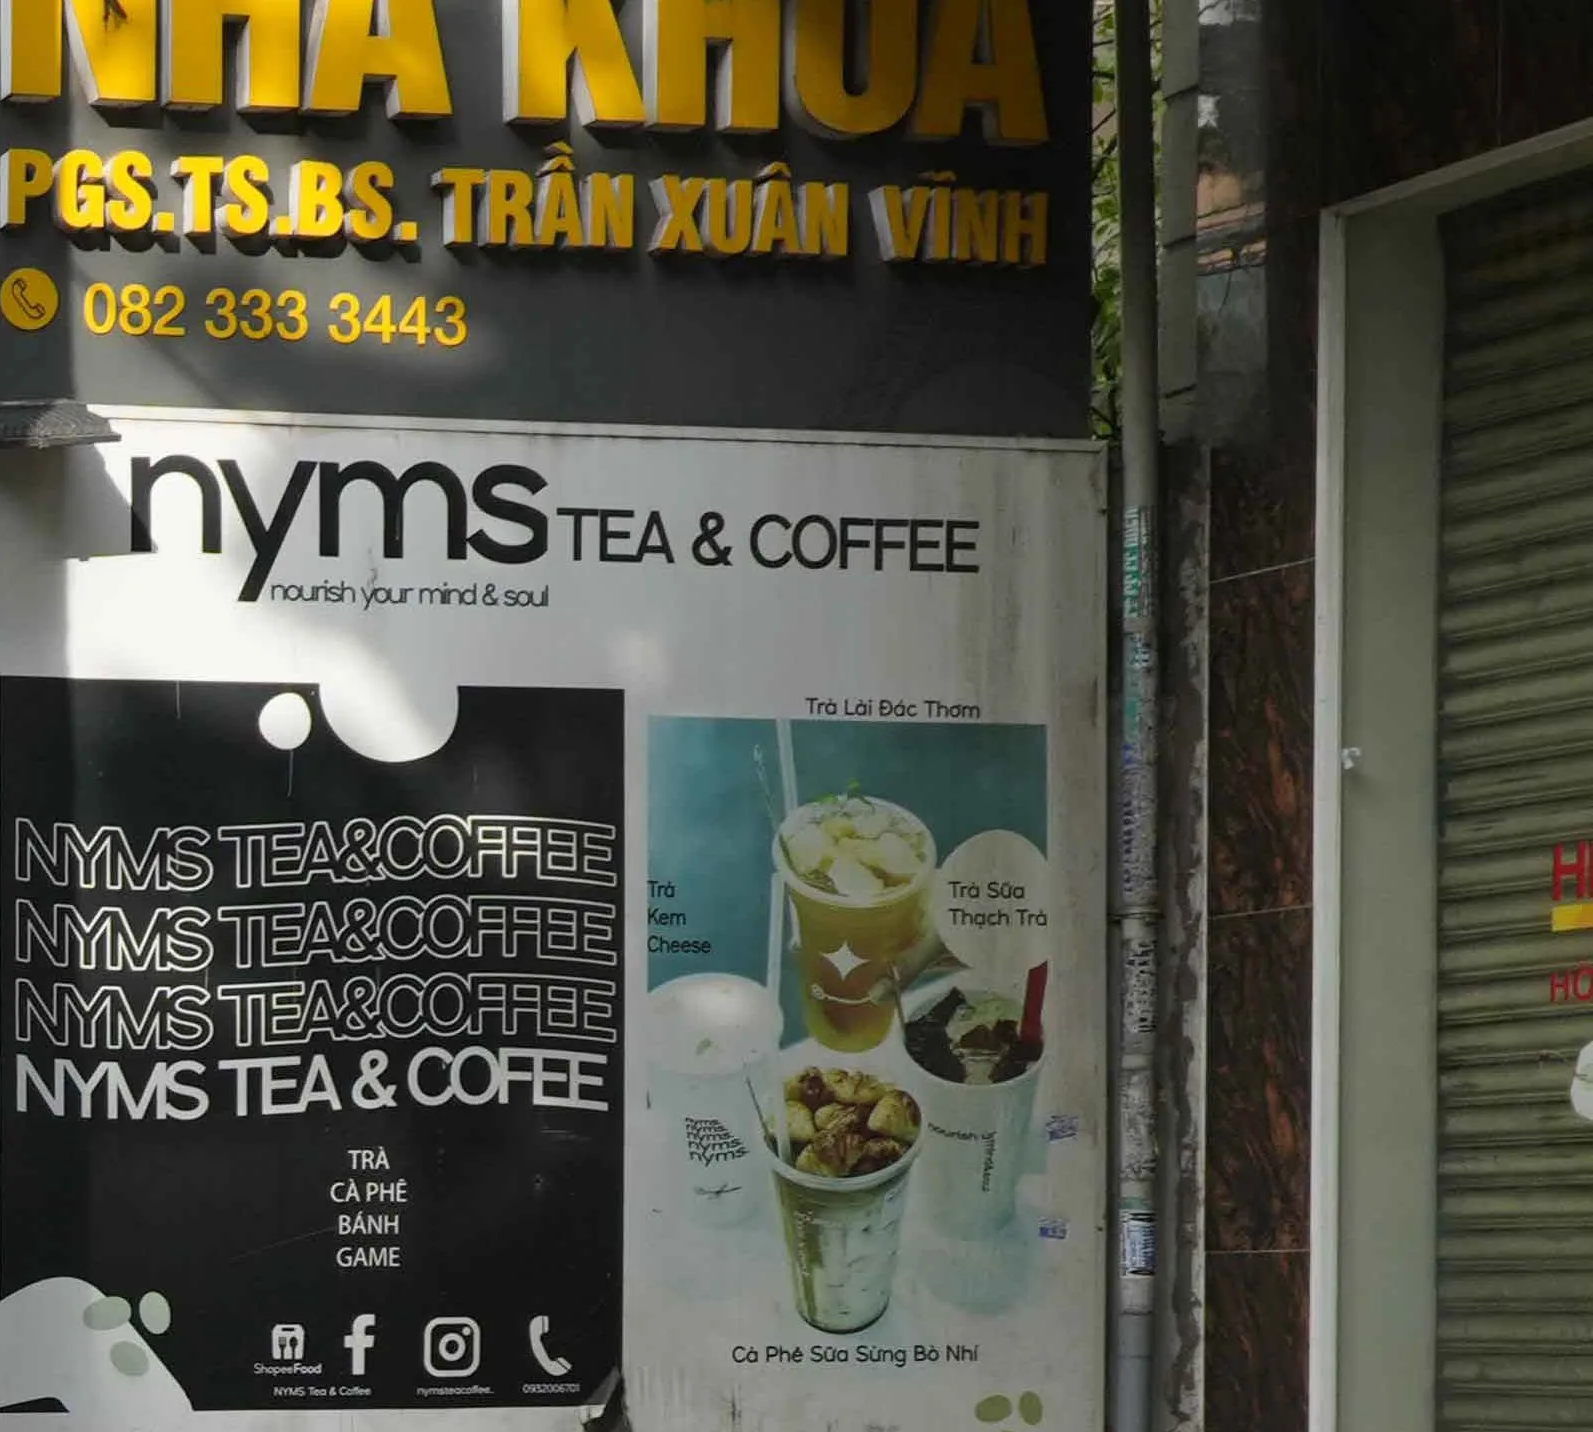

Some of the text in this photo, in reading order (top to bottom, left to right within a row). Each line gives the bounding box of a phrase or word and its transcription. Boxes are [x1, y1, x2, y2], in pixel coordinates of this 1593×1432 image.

[0, 140, 1049, 266] PGS.TS.BS. TRẦN XUÂN VĨNH
[83, 281, 468, 347] 082 333 3443
[130, 454, 980, 602] nyms TEA & COFFEE
[271, 580, 549, 611] nourish your mind & soul
[805, 697, 980, 718] Trà Lài Đác Thơm
[15, 814, 617, 891] NYMS TEA&COFFEE
[647, 880, 675, 898] Trà
[947, 880, 1025, 899] Trà Sữa
[647, 907, 686, 925] Kem
[947, 908, 1047, 929] Thạch Trà
[15, 893, 617, 972] NYMS TEA&COFFEE
[647, 935, 711, 953] Cheese
[15, 972, 617, 1051] NYMS TEA&COFFEE
[16, 1045, 609, 1121] NYMS TEA & COFEE
[348, 1146, 390, 1170] TRÀ
[330, 1178, 407, 1202] CÀ PHÊ
[338, 1211, 399, 1235] BÁNH
[336, 1247, 400, 1267] GAME
[731, 1346, 759, 1363] Cà
[765, 1346, 803, 1363] Phê
[810, 1345, 848, 1363] Sữa
[914, 1345, 940, 1362] Bò
[946, 1345, 979, 1362] Nhí
[254, 1363, 322, 1376] ShopeeFood
[273, 1386, 373, 1396] NYMS Tea & Coffee
